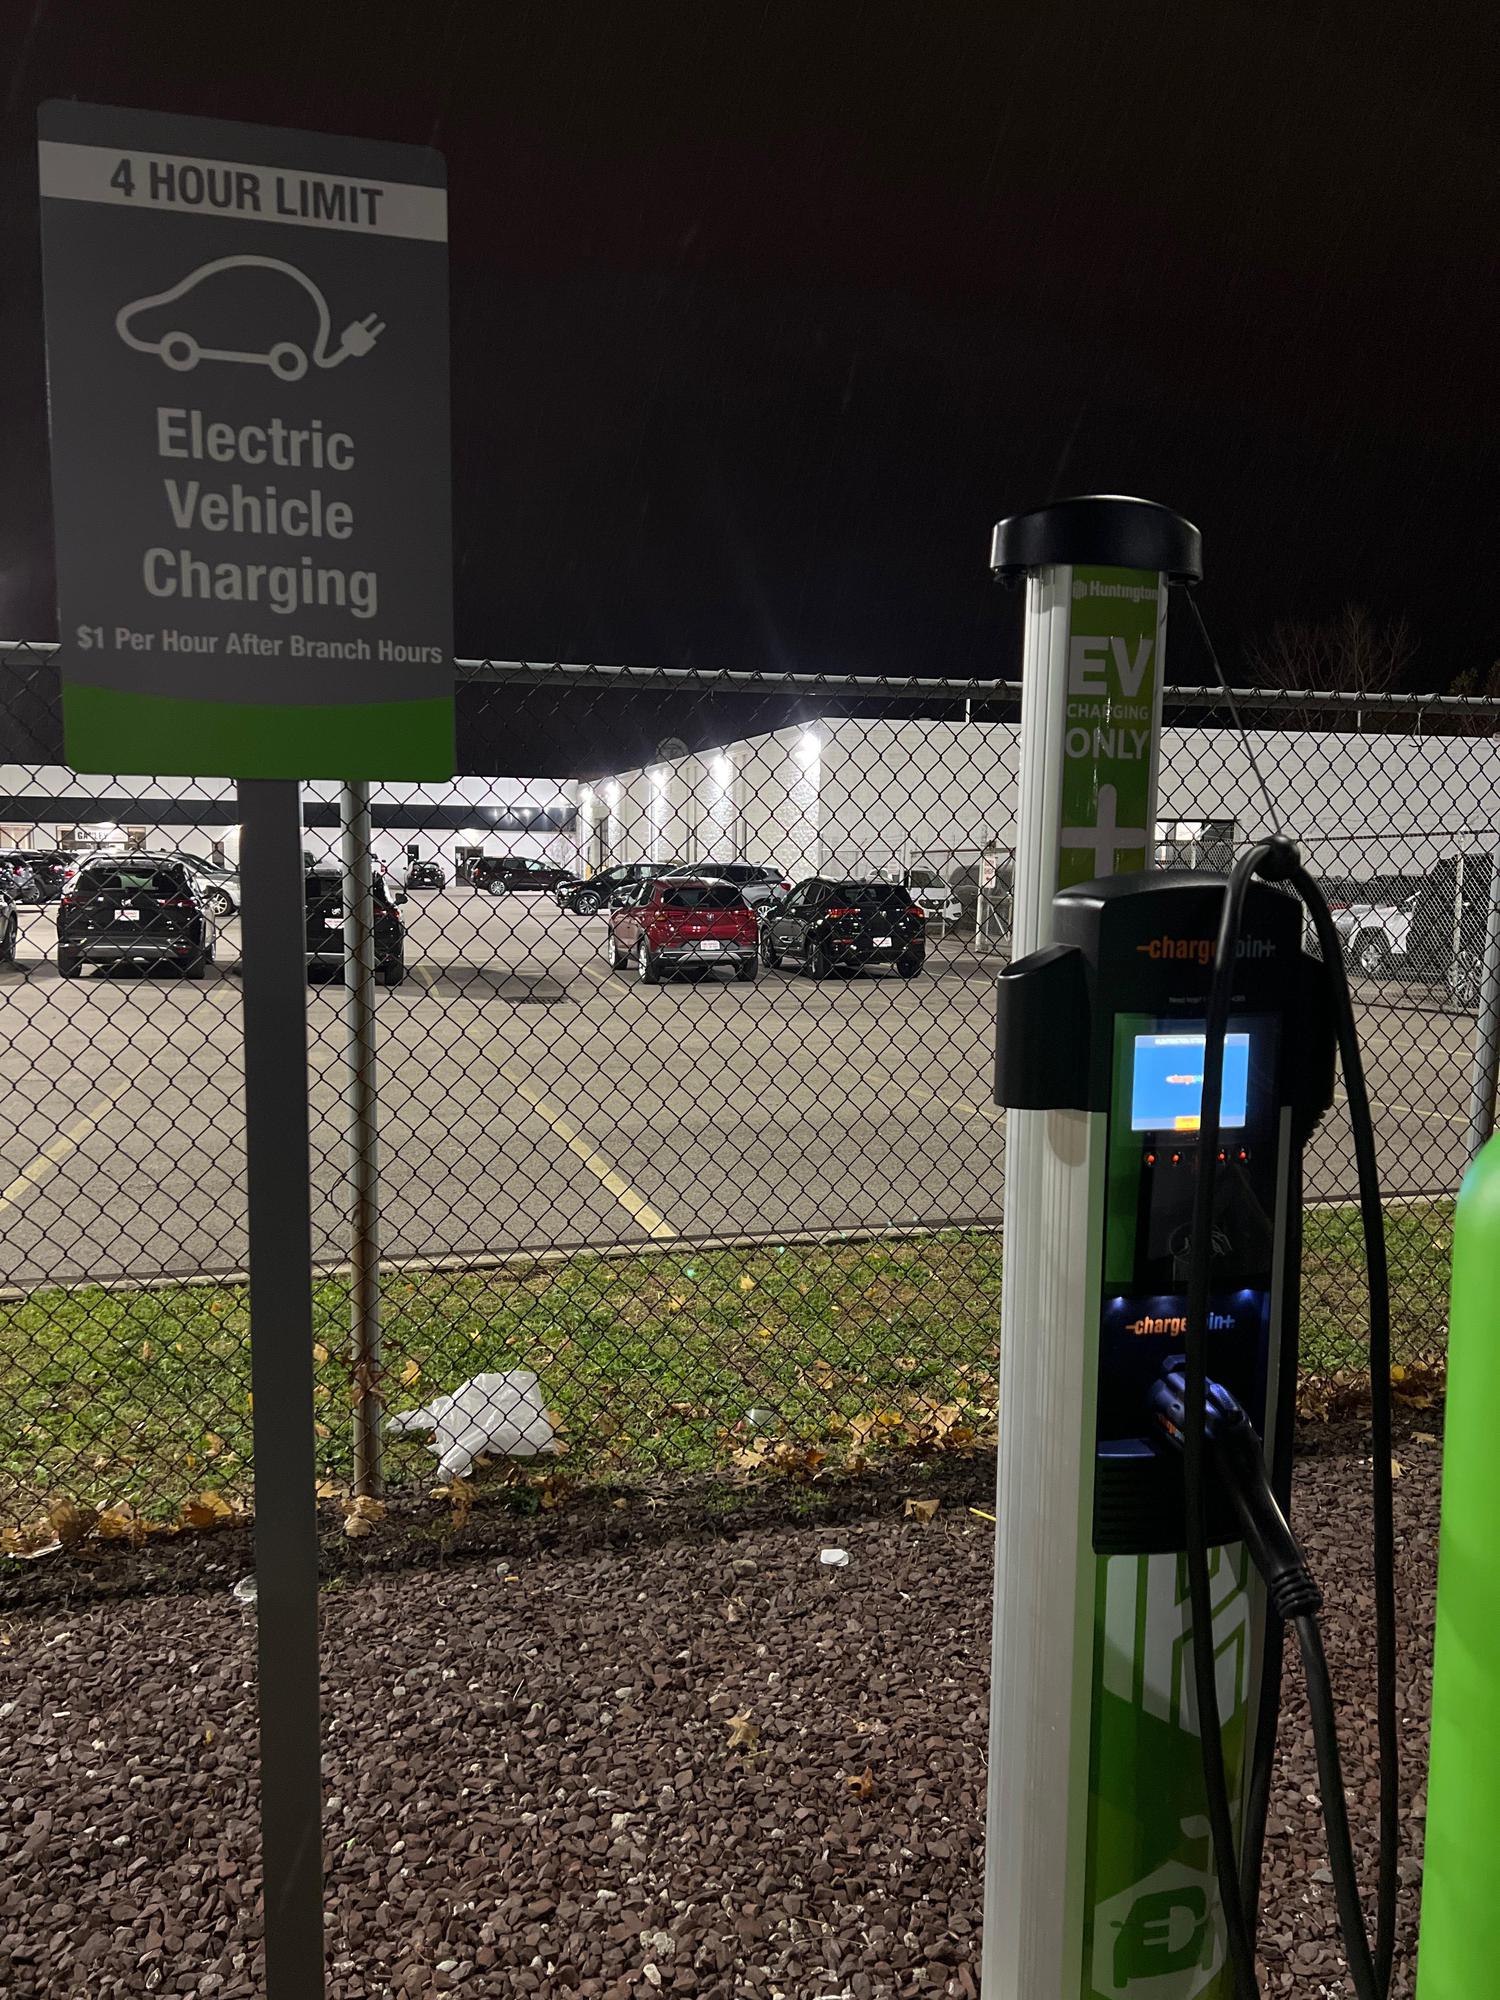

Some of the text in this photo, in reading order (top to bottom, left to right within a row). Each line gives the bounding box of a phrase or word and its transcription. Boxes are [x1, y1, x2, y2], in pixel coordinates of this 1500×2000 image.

[110, 158, 384, 227] 4 HOUR LIMIT
[156, 407, 356, 472] Electric
[164, 479, 355, 540] Vehicle
[142, 547, 379, 619] Charging
[1089, 580, 1159, 602] Huntington
[76, 624, 443, 664] $1 Per Hour After Branch Hours
[1067, 635, 1154, 698] EV
[1067, 703, 1149, 720] CHARGING
[1066, 727, 1151, 760] ONLY
